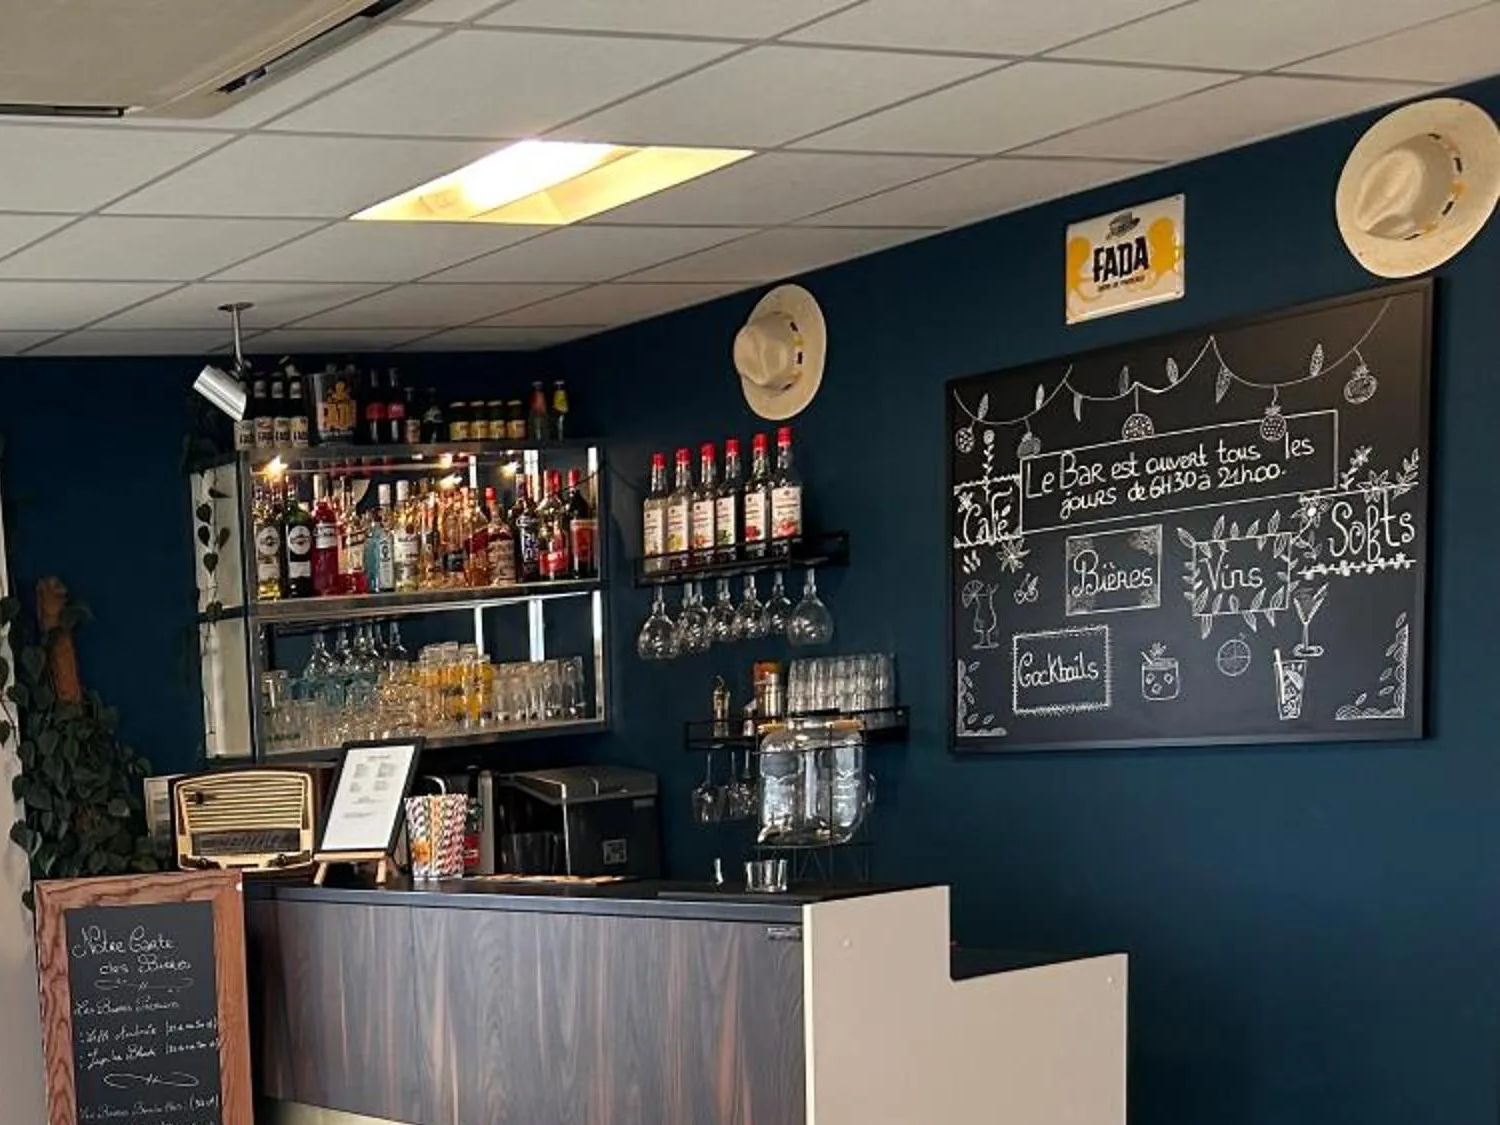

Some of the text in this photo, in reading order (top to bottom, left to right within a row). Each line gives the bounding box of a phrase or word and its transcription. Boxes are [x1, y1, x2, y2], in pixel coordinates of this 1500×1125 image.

[1092, 236, 1150, 282] FADA
[1026, 460, 1055, 498] Le
[1111, 452, 1140, 479] est
[1145, 443, 1209, 475] ouvert
[1218, 439, 1262, 464] tous
[1285, 431, 1315, 460] les
[1127, 483, 1148, 501] de
[963, 486, 1013, 547] Café
[1328, 487, 1415, 563] Softs
[1071, 549, 1154, 598] Bières
[1199, 549, 1263, 591] Vins
[1018, 650, 1099, 688] Cocktails
